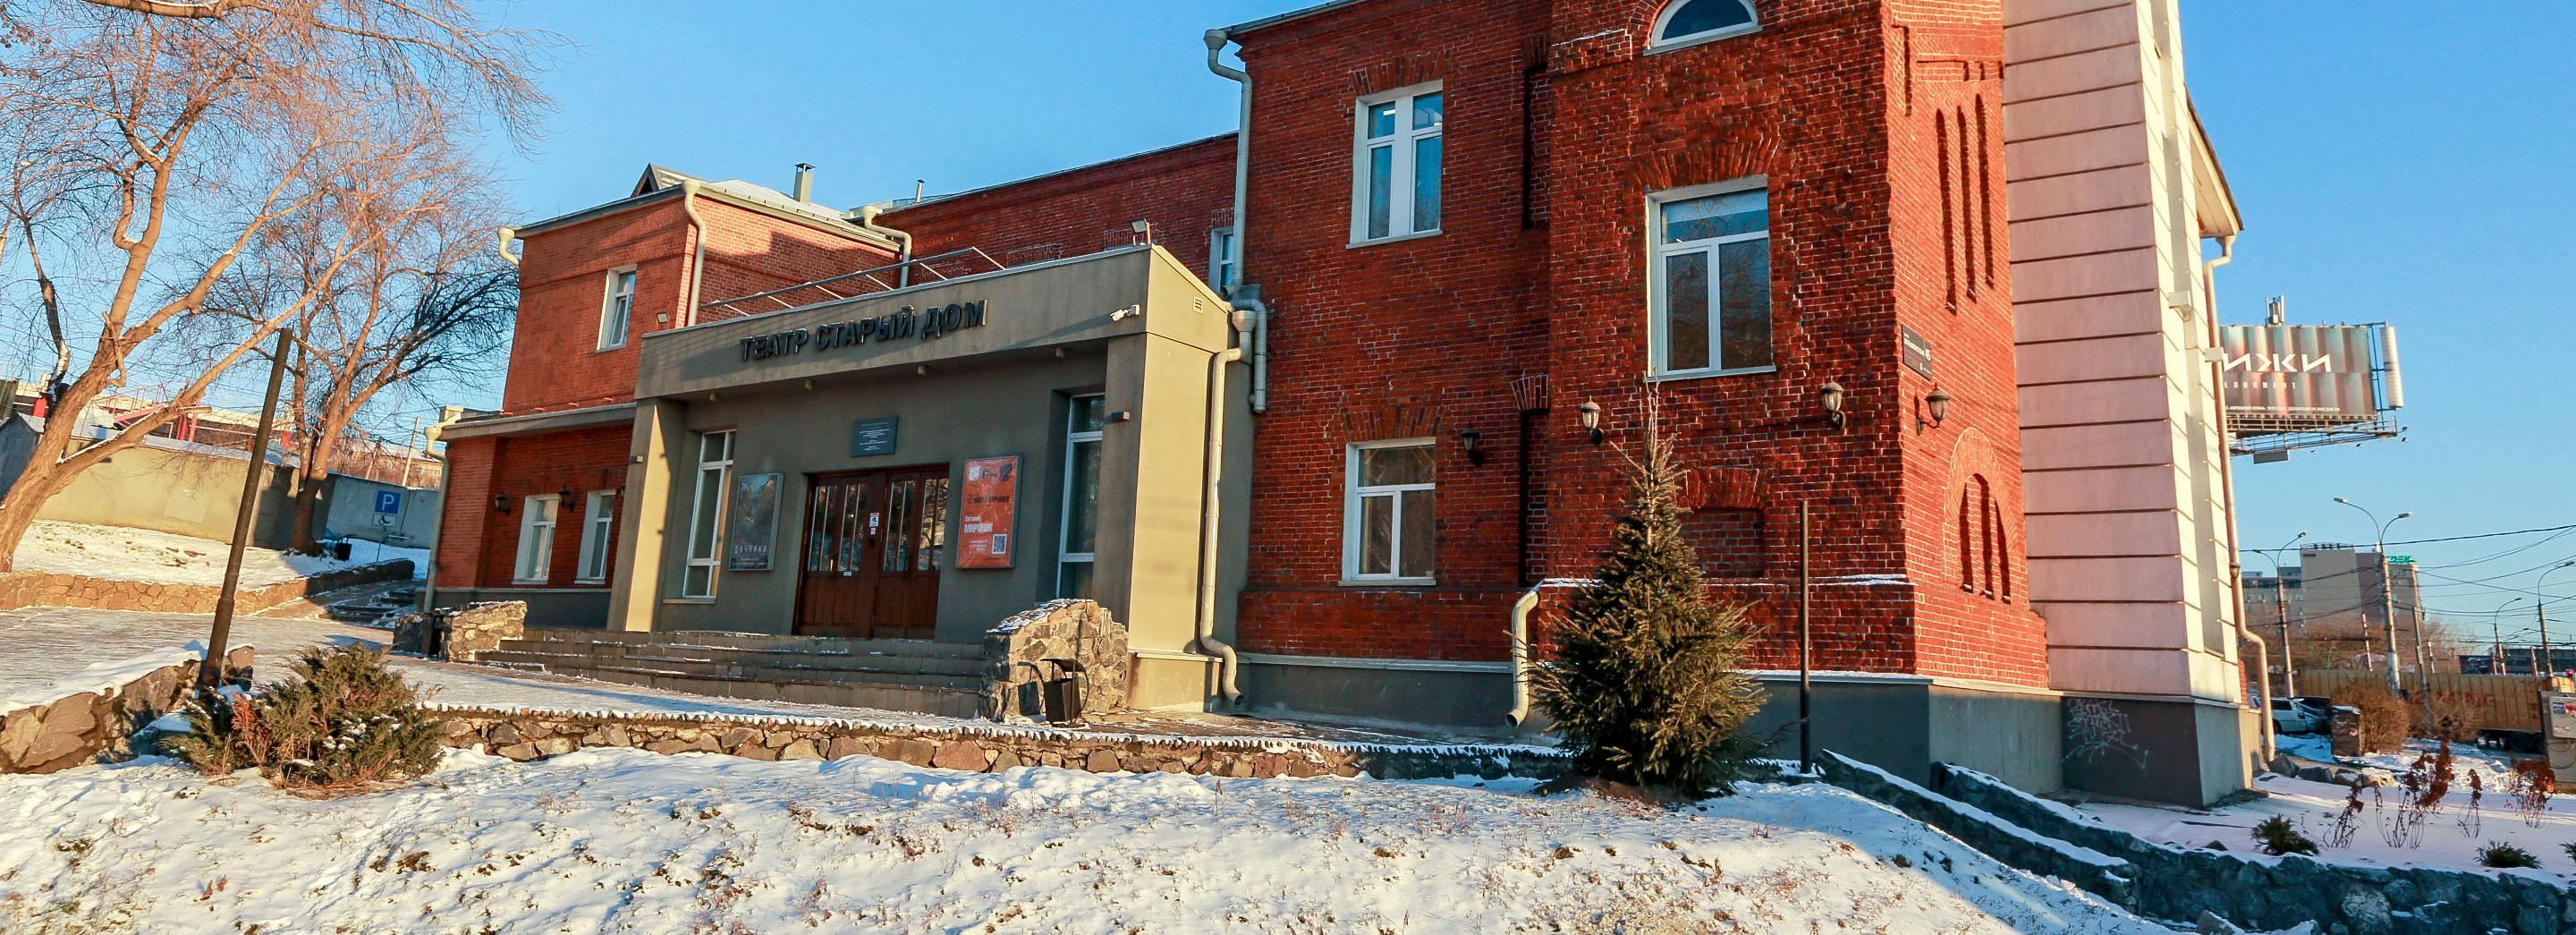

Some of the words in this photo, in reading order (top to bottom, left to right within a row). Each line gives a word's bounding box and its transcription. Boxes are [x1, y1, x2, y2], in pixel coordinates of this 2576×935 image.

[740, 327, 809, 361] ТЕАТР
[815, 304, 916, 351] СТАРЫЙ
[920, 299, 988, 340] ДОМ
[382, 493, 394, 511] P
